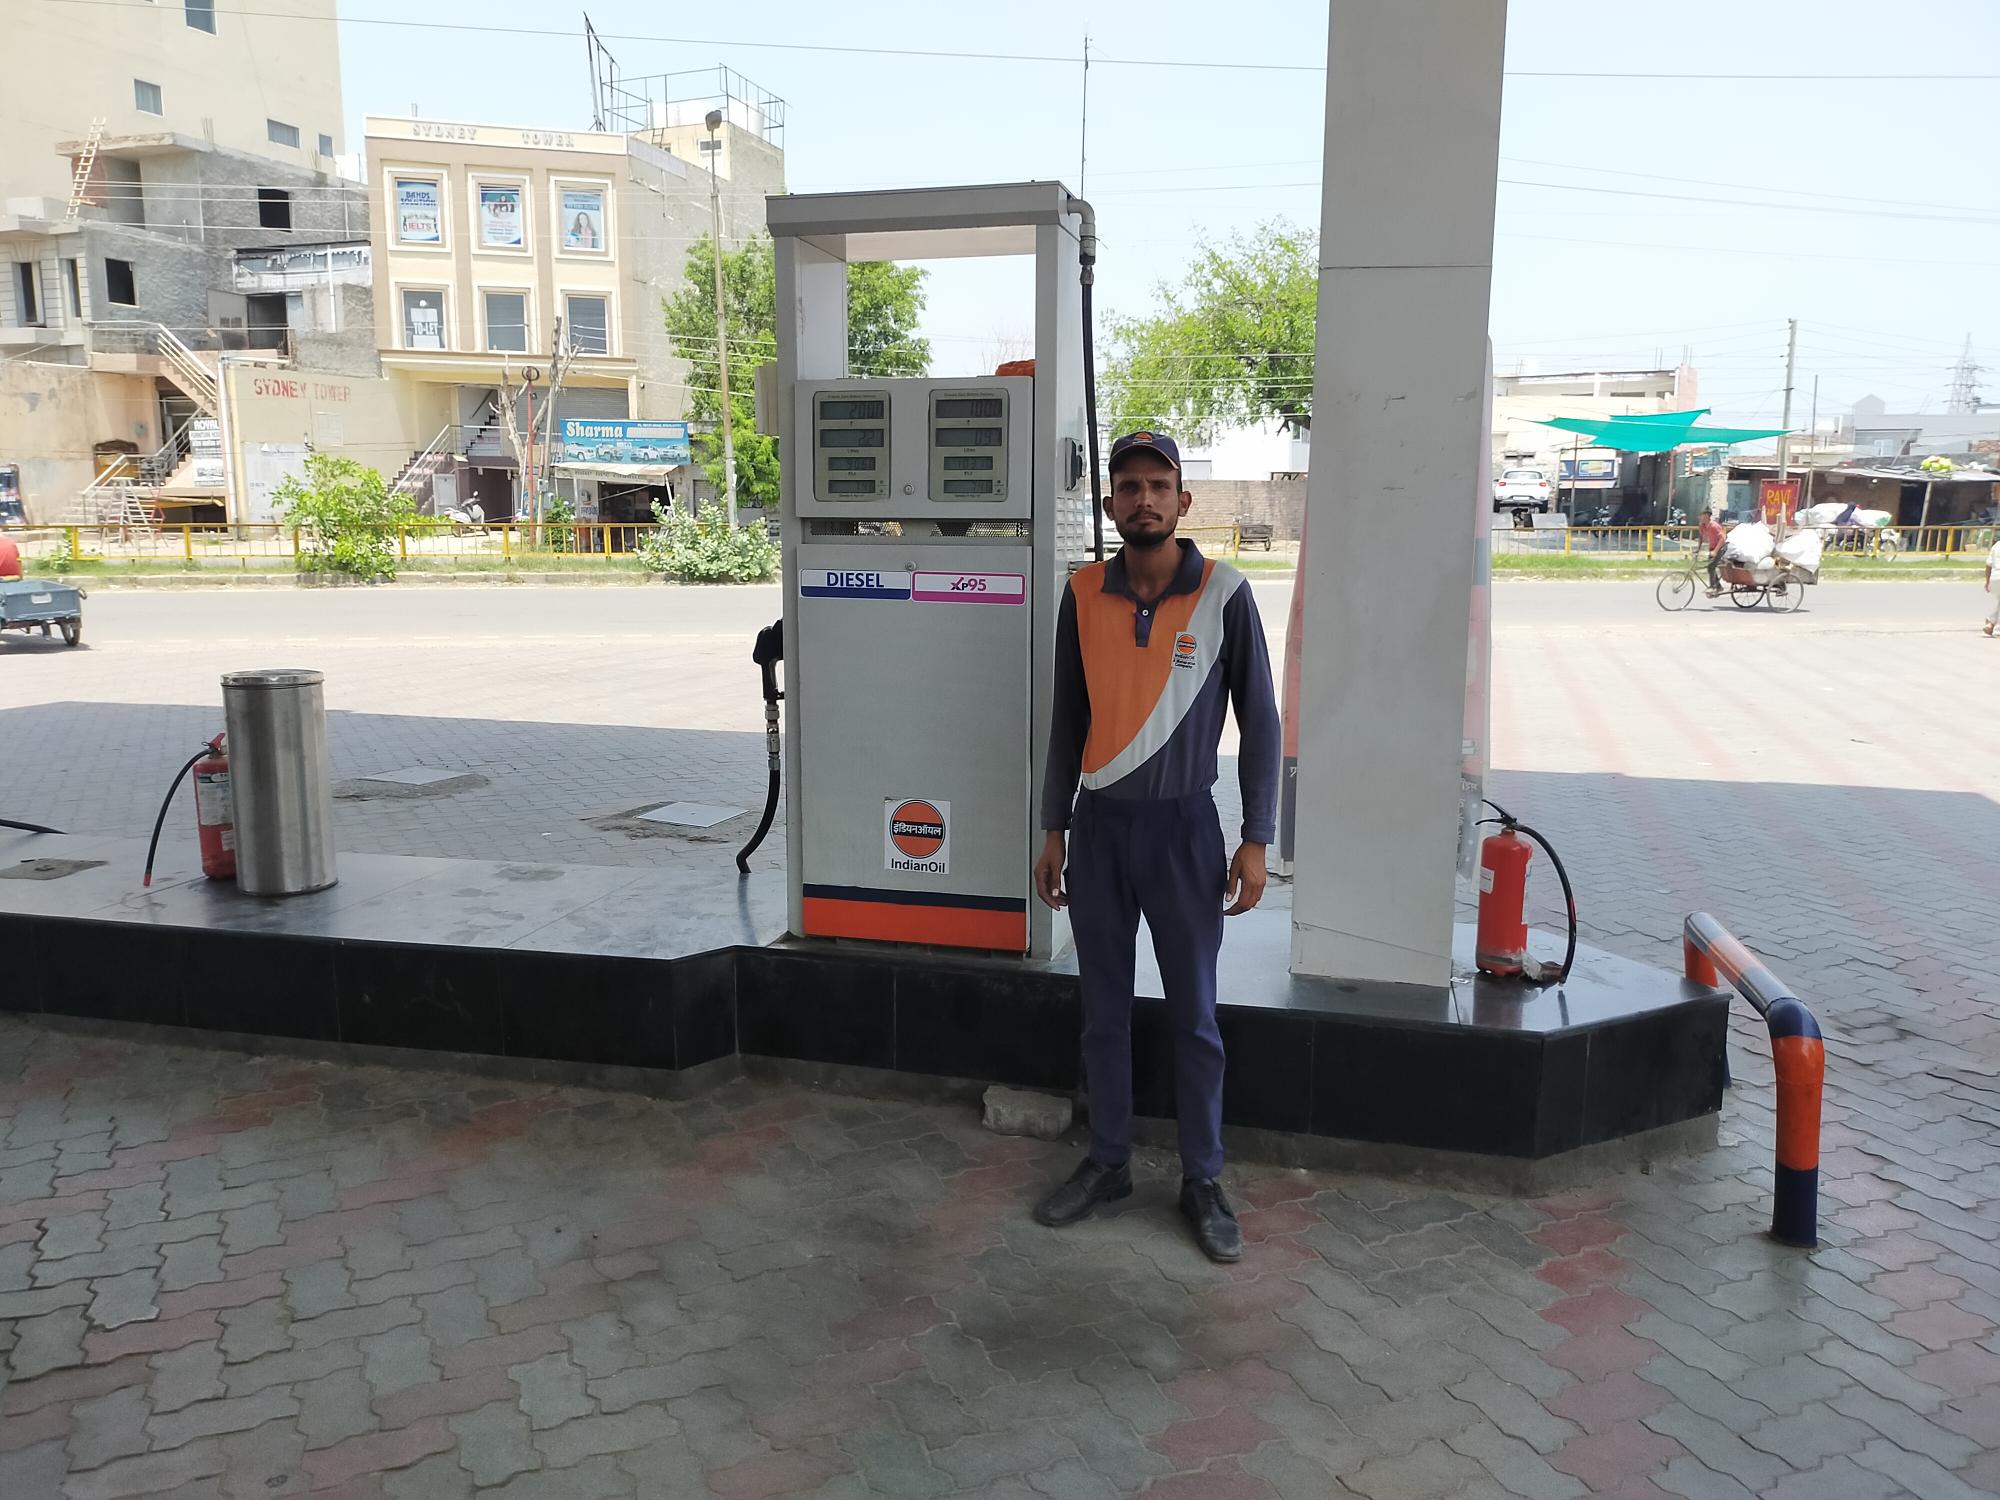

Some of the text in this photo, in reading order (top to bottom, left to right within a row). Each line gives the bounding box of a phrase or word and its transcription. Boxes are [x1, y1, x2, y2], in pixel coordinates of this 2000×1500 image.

[412, 123, 575, 148] SYDNEY TOWER
[408, 222, 432, 230] IELTS
[253, 378, 307, 399] SYDNEY
[193, 419, 220, 431] ROYAL
[566, 421, 623, 439] Sharma
[1767, 489, 1791, 505] RAVI
[826, 571, 885, 588] DIESEL
[893, 822, 942, 836] इंडियनऑयल
[891, 858, 945, 873] IndianOil
